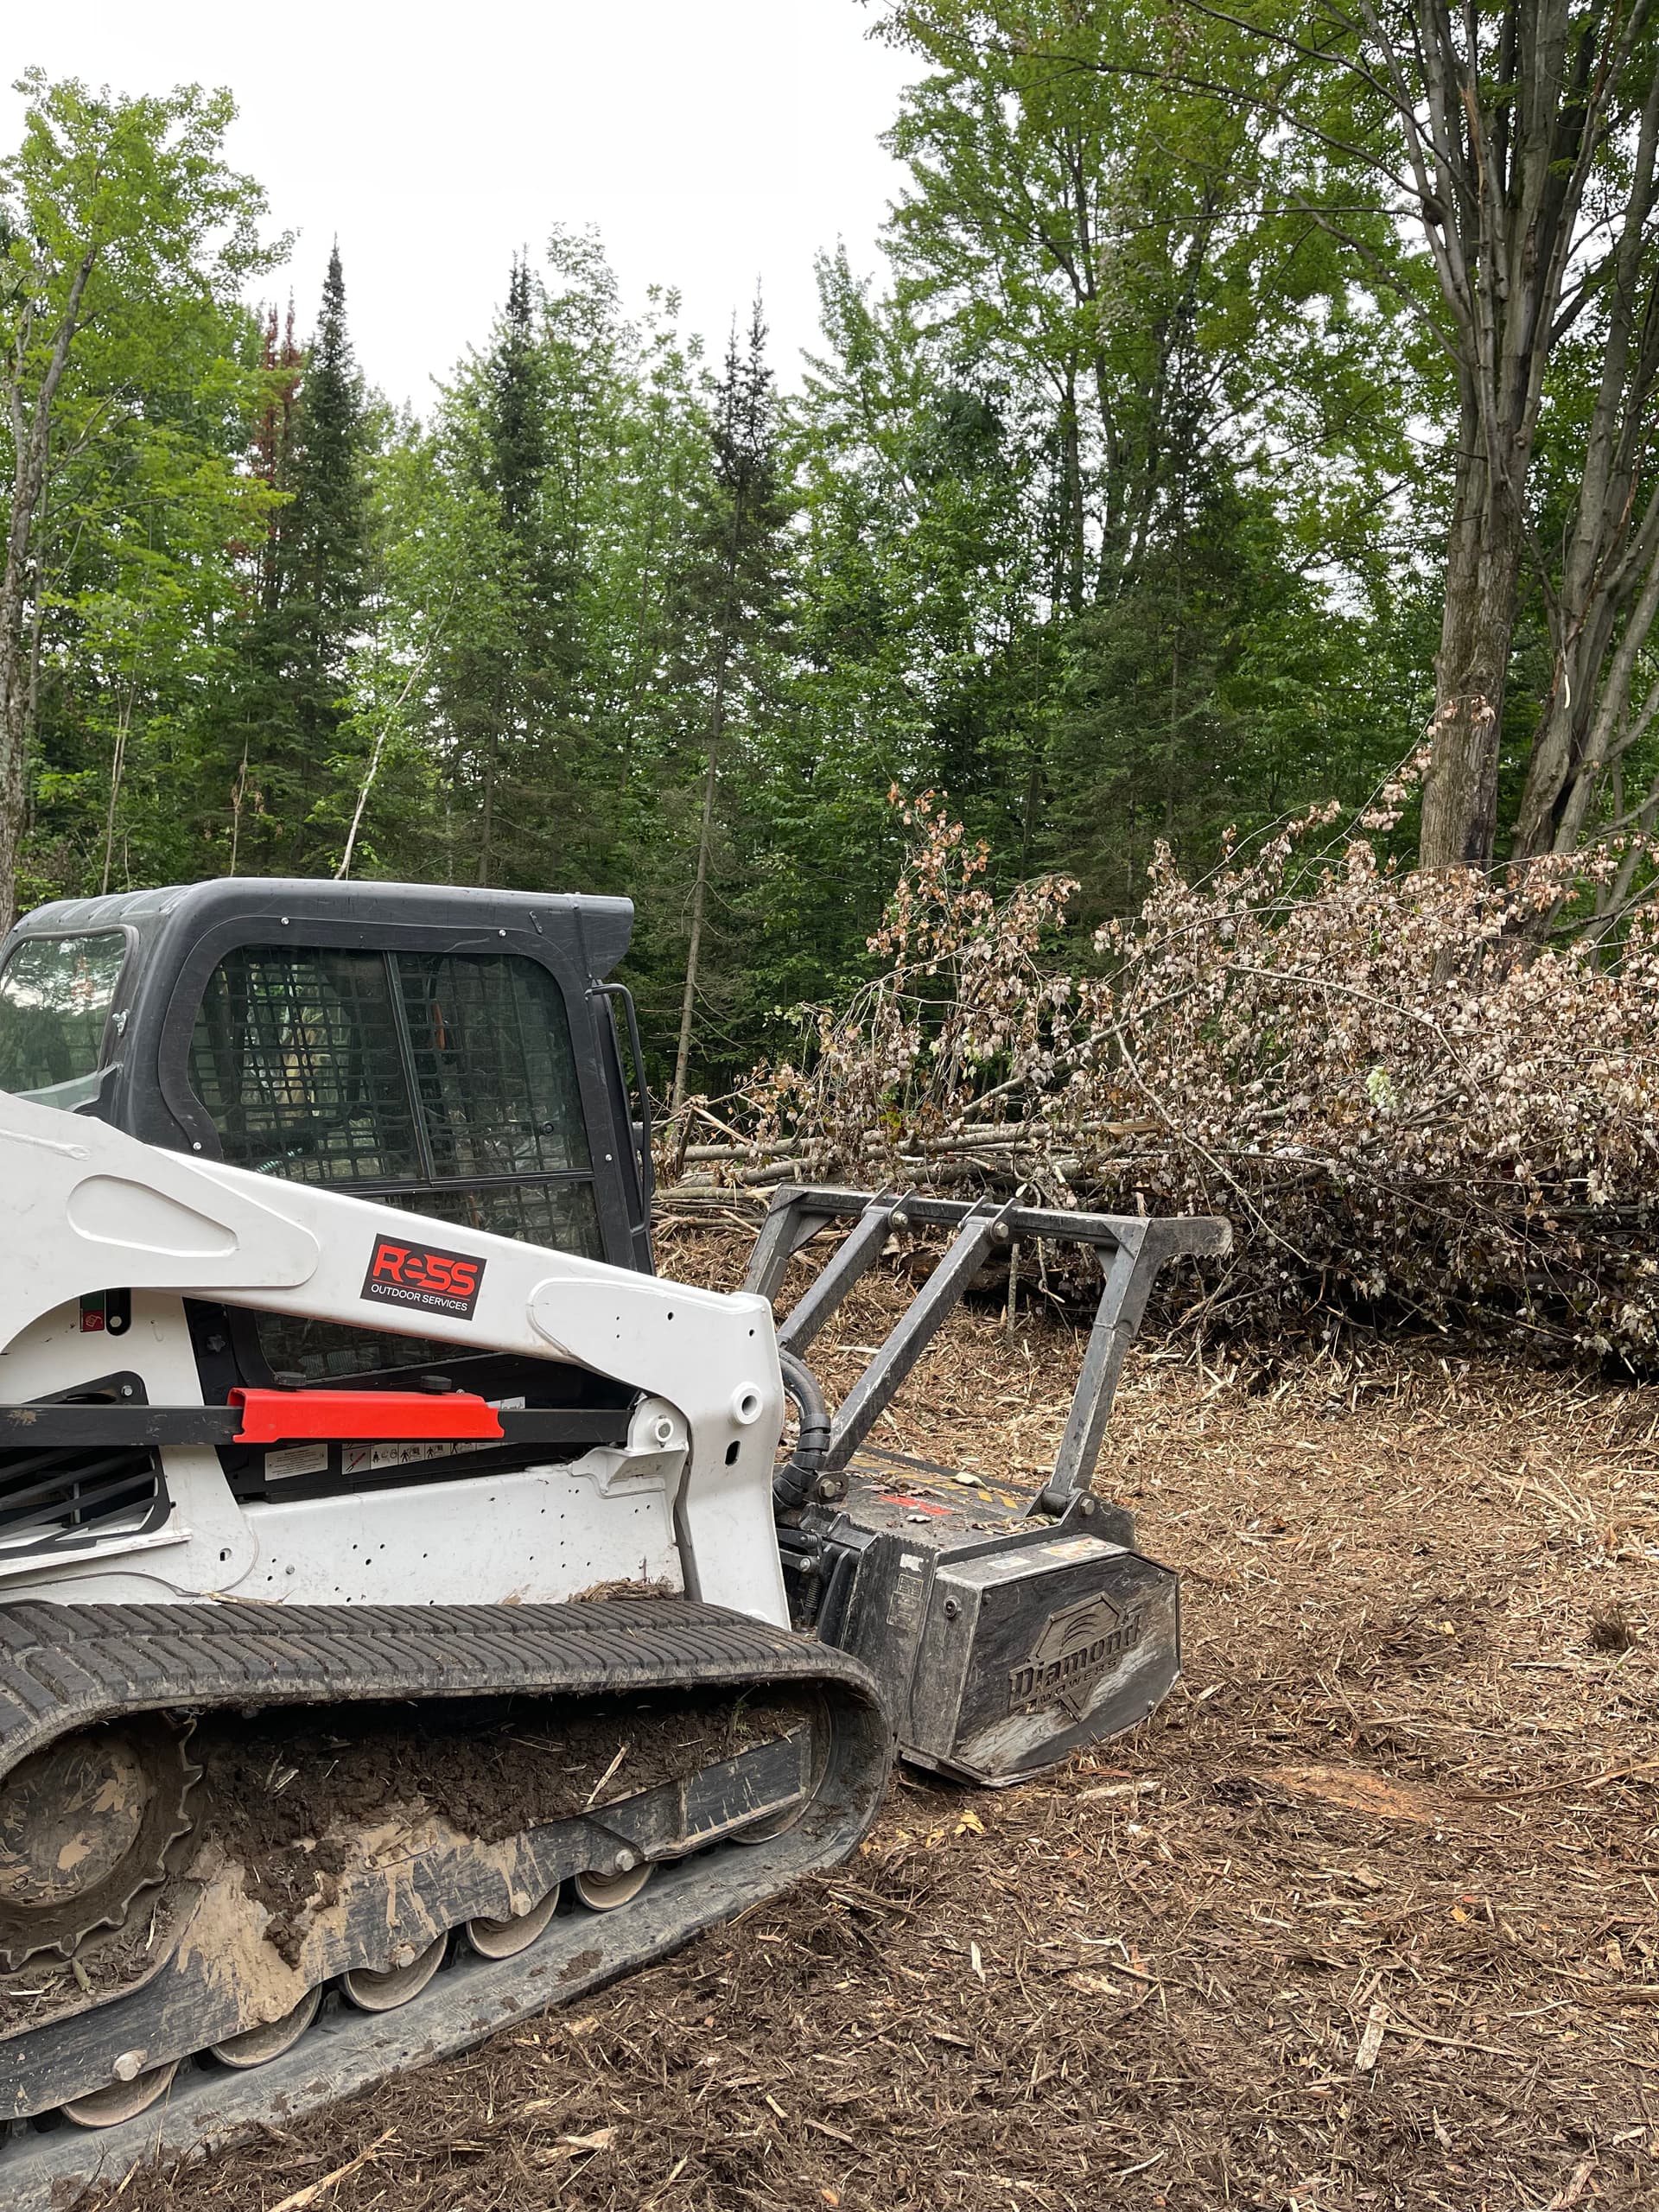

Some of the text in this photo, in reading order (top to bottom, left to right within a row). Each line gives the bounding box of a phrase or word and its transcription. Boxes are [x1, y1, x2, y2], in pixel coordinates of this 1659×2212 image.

[371, 1284, 467, 1312] OUTDOOR SERVICES
[1009, 1613, 1141, 1708] Diamond
[1039, 1657, 1117, 1704] MOWERS
